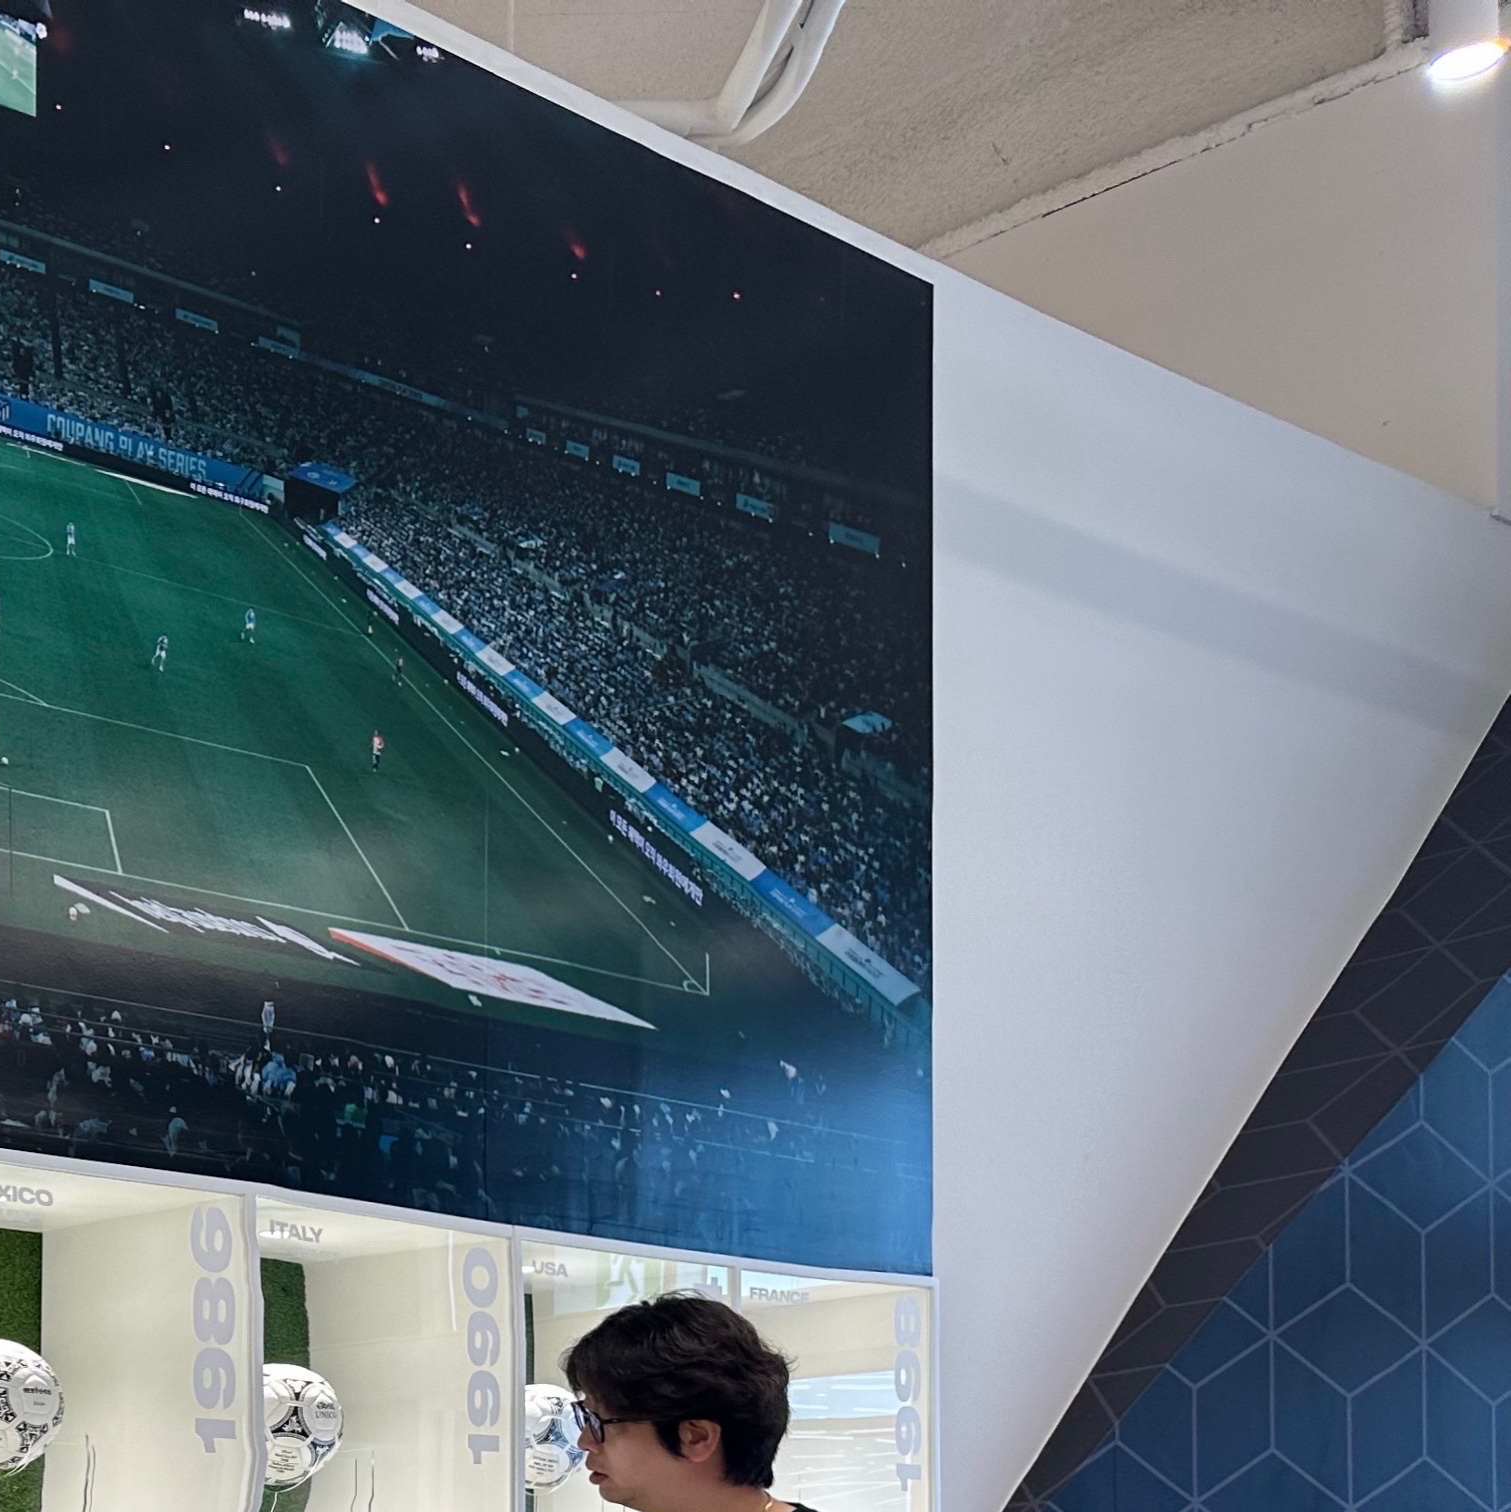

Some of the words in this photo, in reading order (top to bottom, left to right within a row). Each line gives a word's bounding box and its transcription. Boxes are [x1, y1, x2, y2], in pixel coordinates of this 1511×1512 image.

[46, 413, 114, 451] COUPANG
[119, 434, 155, 460] PLAY
[158, 447, 206, 481] SERIES
[269, 1219, 323, 1243] ITALY
[532, 1260, 568, 1278] USA
[749, 1286, 809, 1303] FRANCE
[190, 1206, 236, 1454] 1986
[462, 1247, 501, 1465] 1990
[893, 1296, 922, 1491] 1998
